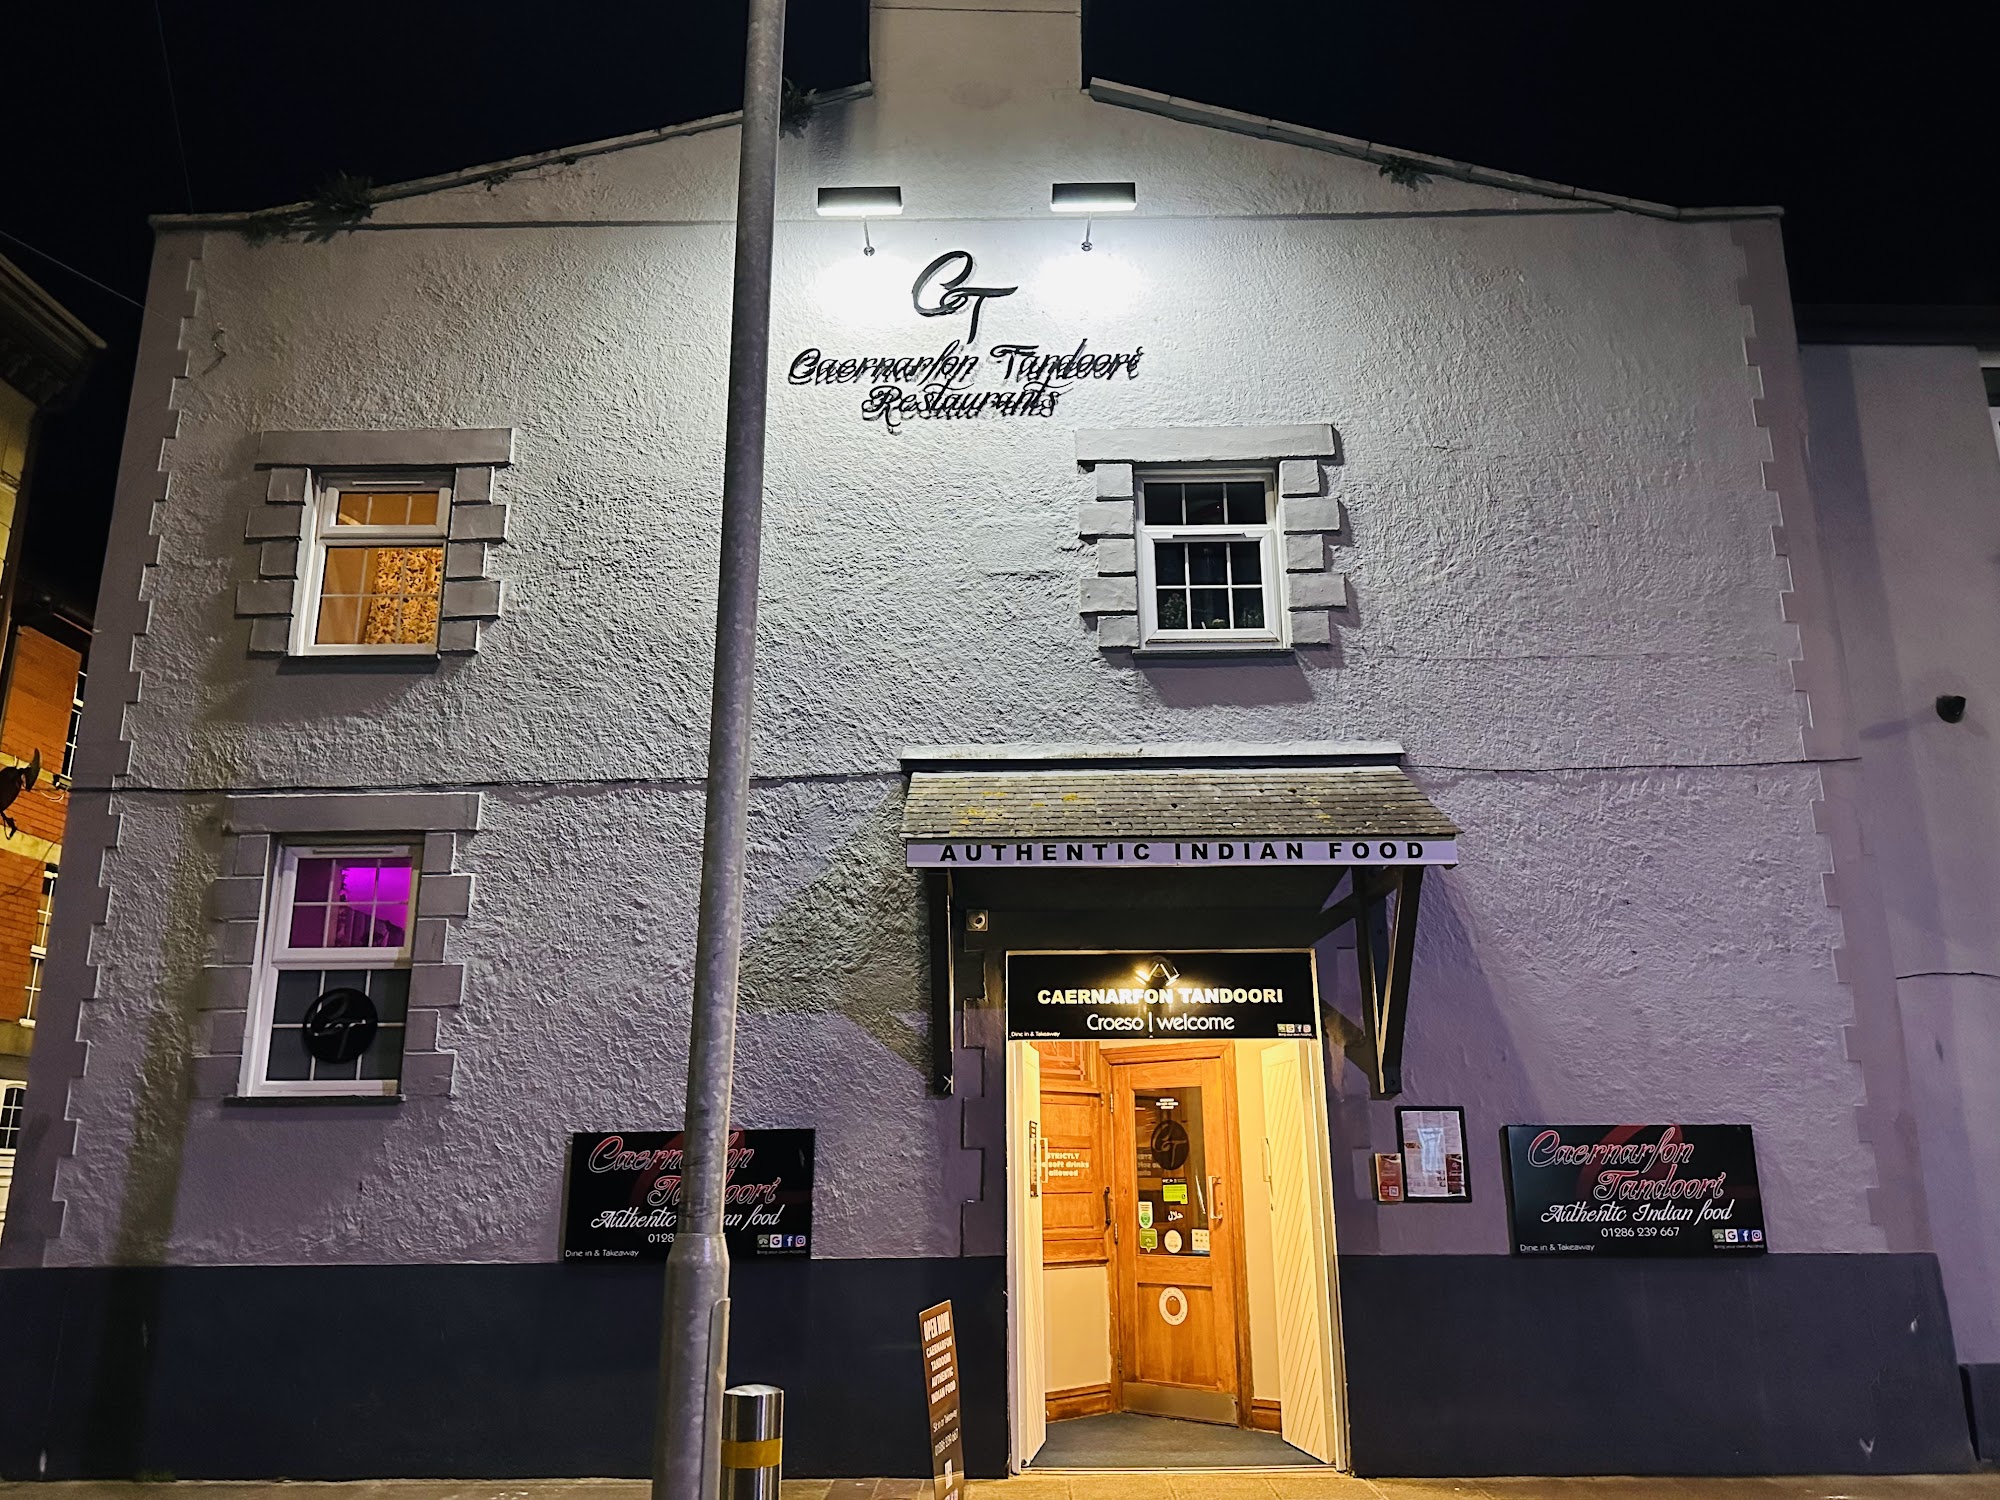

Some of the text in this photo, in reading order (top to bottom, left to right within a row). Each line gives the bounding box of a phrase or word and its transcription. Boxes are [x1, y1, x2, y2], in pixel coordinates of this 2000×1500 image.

[788, 339, 1144, 384] Caernarfon Tandoori
[861, 377, 1068, 432] Restaurants
[940, 841, 1424, 862] AUTHENTIC INDIAN FOOD
[1037, 988, 1284, 1004] CAERNARFON TANDOORI
[1086, 1012, 1235, 1031] Croeso welcome
[588, 1132, 755, 1174] Caernon
[1527, 1126, 1695, 1173] Caernarfon
[1593, 1163, 1727, 1200] Tandoori
[590, 1206, 677, 1228] Authentic
[741, 1204, 786, 1231] food
[1540, 1199, 1736, 1226] Authentic Indian food
[648, 1233, 675, 1243] 0128
[1601, 1226, 1680, 1238] 01286 239 667
[565, 1249, 583, 1257] Dine
[602, 1249, 640, 1257] Takeaway
[1519, 1244, 1539, 1252] Dine
[1549, 1243, 1556, 1251] &
[1557, 1243, 1595, 1252] Takeaway
